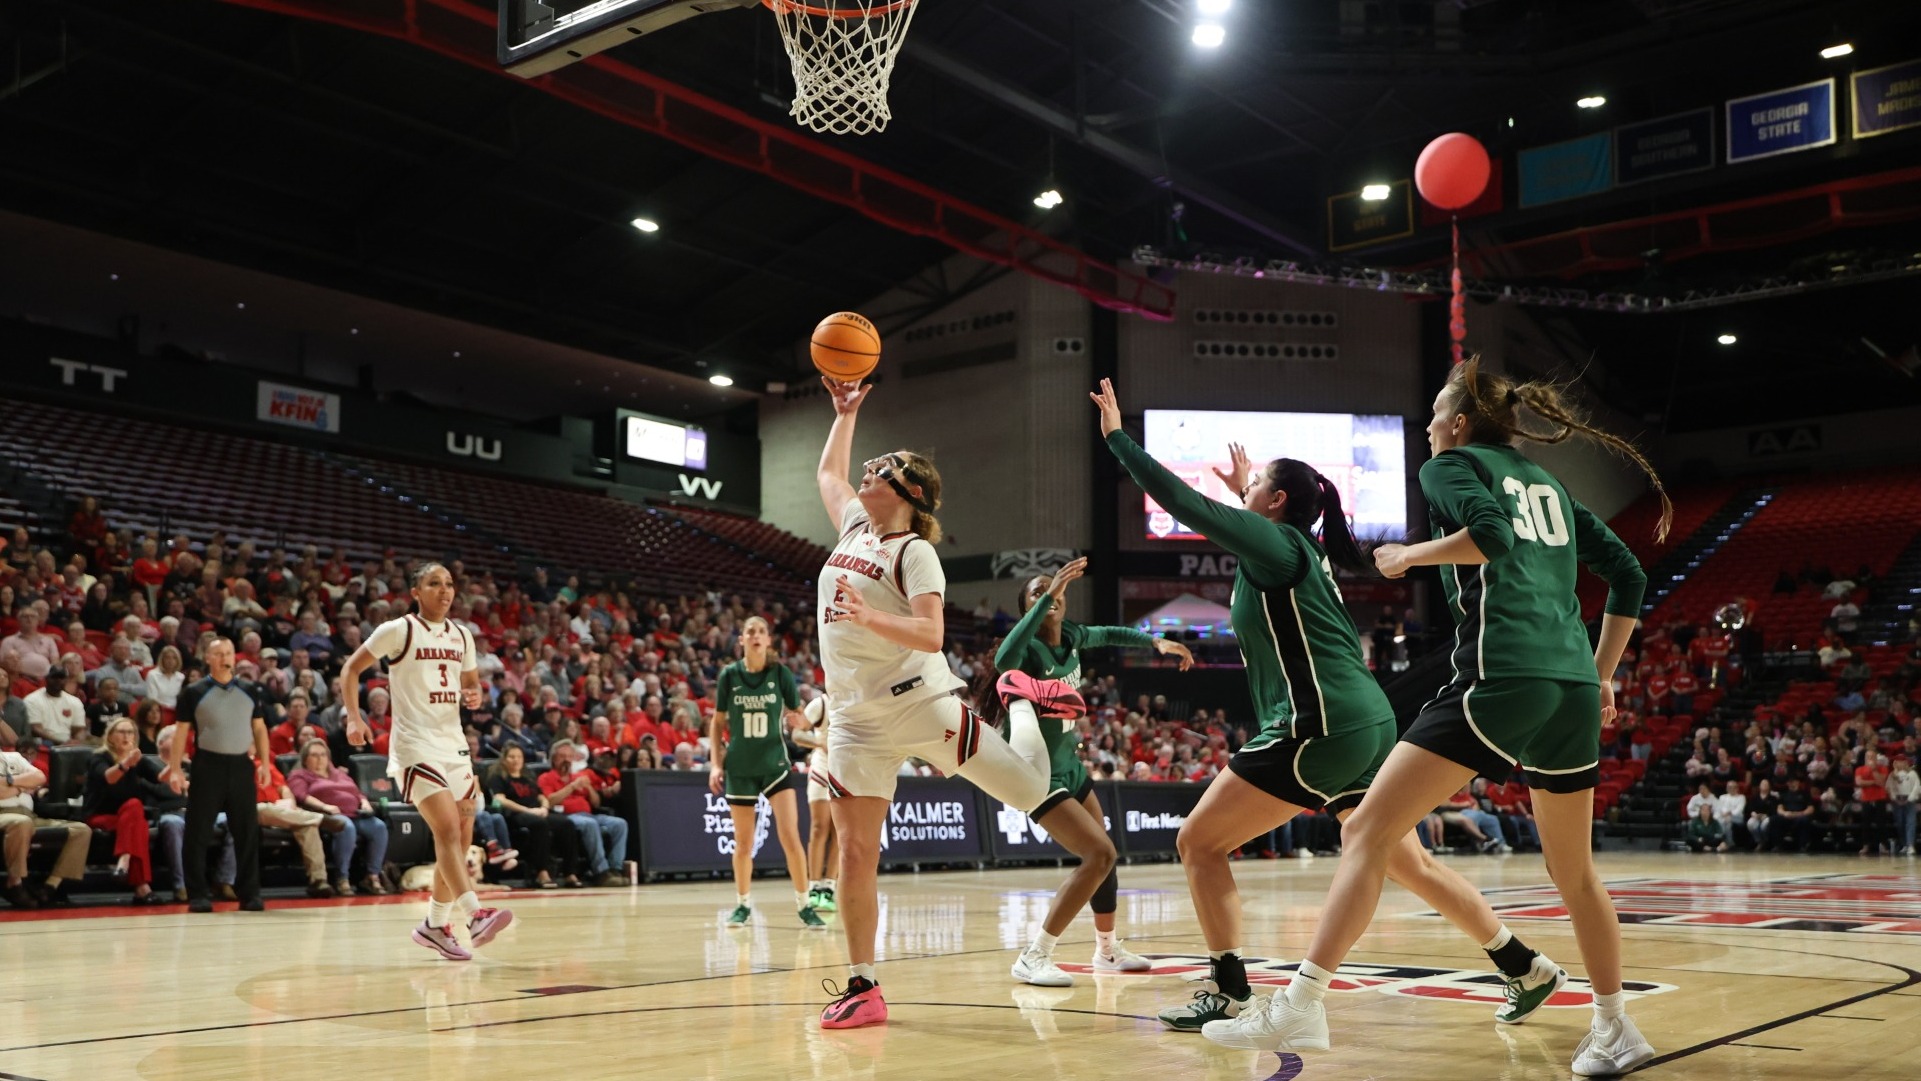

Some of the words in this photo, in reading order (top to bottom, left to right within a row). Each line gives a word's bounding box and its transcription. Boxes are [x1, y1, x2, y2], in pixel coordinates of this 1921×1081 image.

[1751, 101, 1809, 127] GEORGIA
[1758, 119, 1801, 142] STATE
[49, 357, 128, 393] TT
[269, 400, 318, 422] KFIN
[446, 431, 502, 461] UU
[679, 474, 722, 499] VV
[1502, 476, 1569, 547] 30
[1180, 554, 1237, 576] PAC
[437, 663, 448, 687] 3
[429, 691, 457, 704] STATE
[734, 693, 777, 705] CLEVELAND
[742, 712, 768, 738] 10
[890, 801, 965, 825] KALMER
[1160, 812, 1186, 829] Natio
[892, 825, 966, 841] SOLUTIONS
